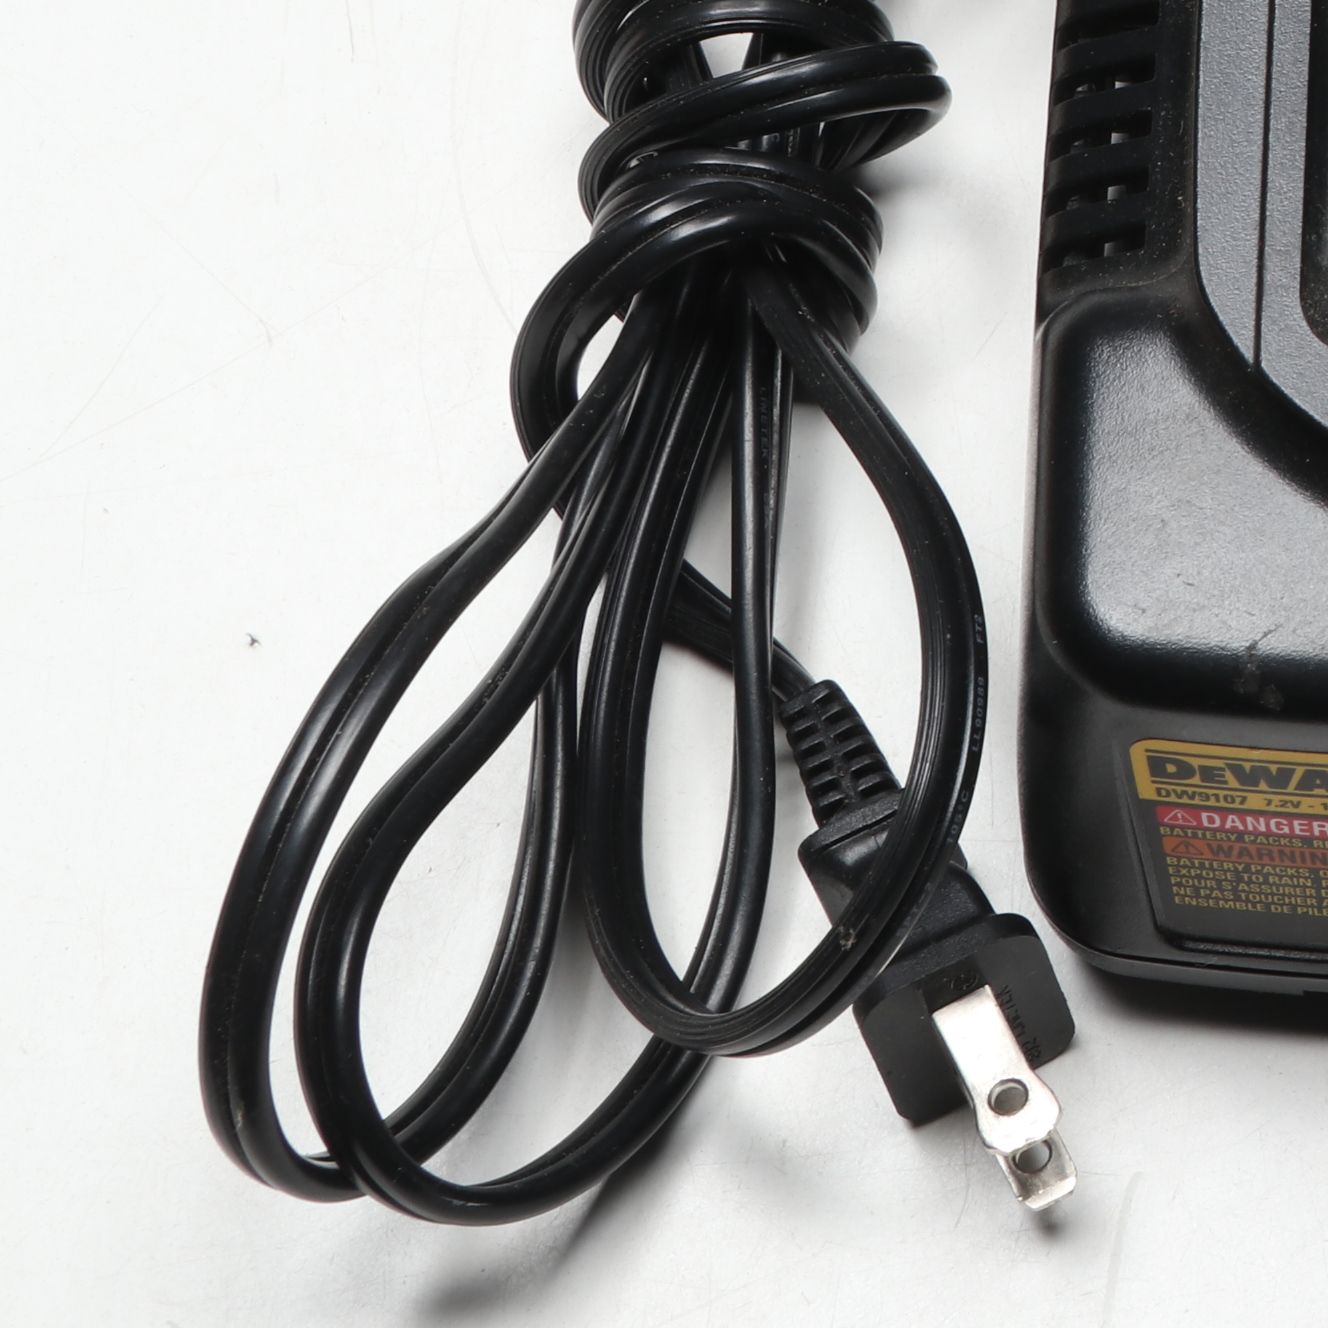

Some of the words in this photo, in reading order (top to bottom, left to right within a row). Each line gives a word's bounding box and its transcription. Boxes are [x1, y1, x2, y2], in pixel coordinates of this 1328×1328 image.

[1156, 787, 1248, 805] DW9107
[1264, 799, 1301, 809] 7.2V
[1160, 826, 1239, 841] BATTERY
[1167, 857, 1245, 871] BATTERY
[1168, 867, 1237, 881] EXPOSE
[1243, 873, 1264, 883] TO
[1171, 877, 1216, 890] POUR
[1222, 882, 1316, 897] S'ASSURER
[1172, 887, 1196, 896] NE
[1200, 890, 1234, 900] PAS
[1240, 893, 1317, 906] TOUCHER
[1175, 896, 1265, 912] ENSEMBLE
[1271, 904, 1292, 914] DE
